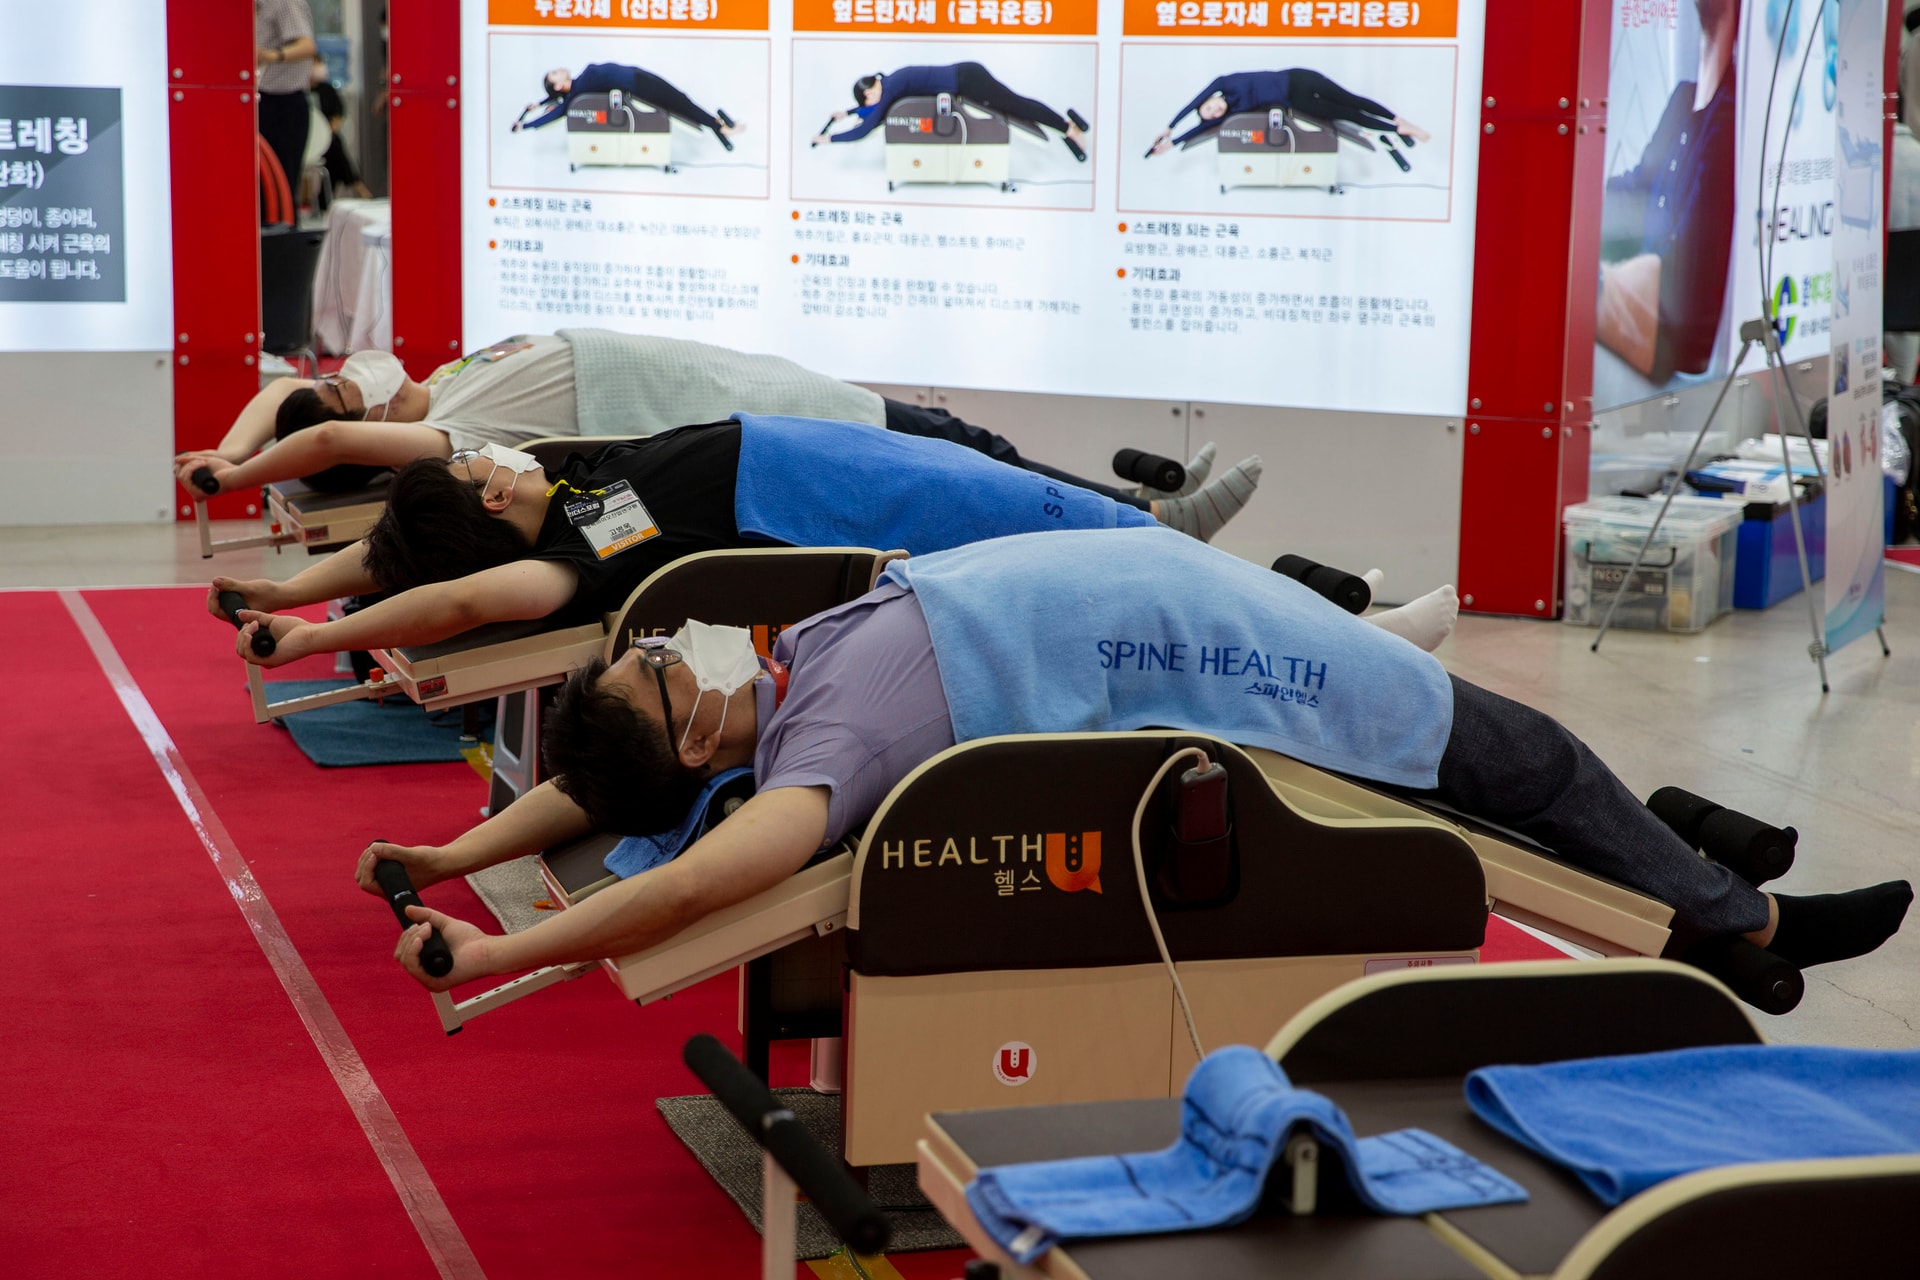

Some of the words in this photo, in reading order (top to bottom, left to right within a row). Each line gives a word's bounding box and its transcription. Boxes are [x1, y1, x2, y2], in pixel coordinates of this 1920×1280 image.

[832, 0, 937, 24] 엎드린자세
[1155, 1, 1268, 26] 옆으로자세
[1281, 1, 1420, 27] (옆구리운동)
[805, 210, 850, 224] 스트레칭
[855, 211, 876, 226] 되는
[880, 212, 904, 226] 근육
[1133, 222, 1182, 237] 스트레칭
[1186, 223, 1210, 238] 되는
[1215, 224, 1240, 239] 근육
[28, 233, 59, 254] 시켜
[0, 258, 46, 280] 도움이
[805, 253, 850, 268] 기대효과
[1132, 266, 1180, 282] 기대효과
[611, 532, 644, 551] VISITOR
[1097, 640, 1188, 672] SPINE
[1200, 645, 1327, 690] HEALTH
[1244, 681, 1320, 708] 스파인헬스
[994, 869, 1042, 896] 헬스
